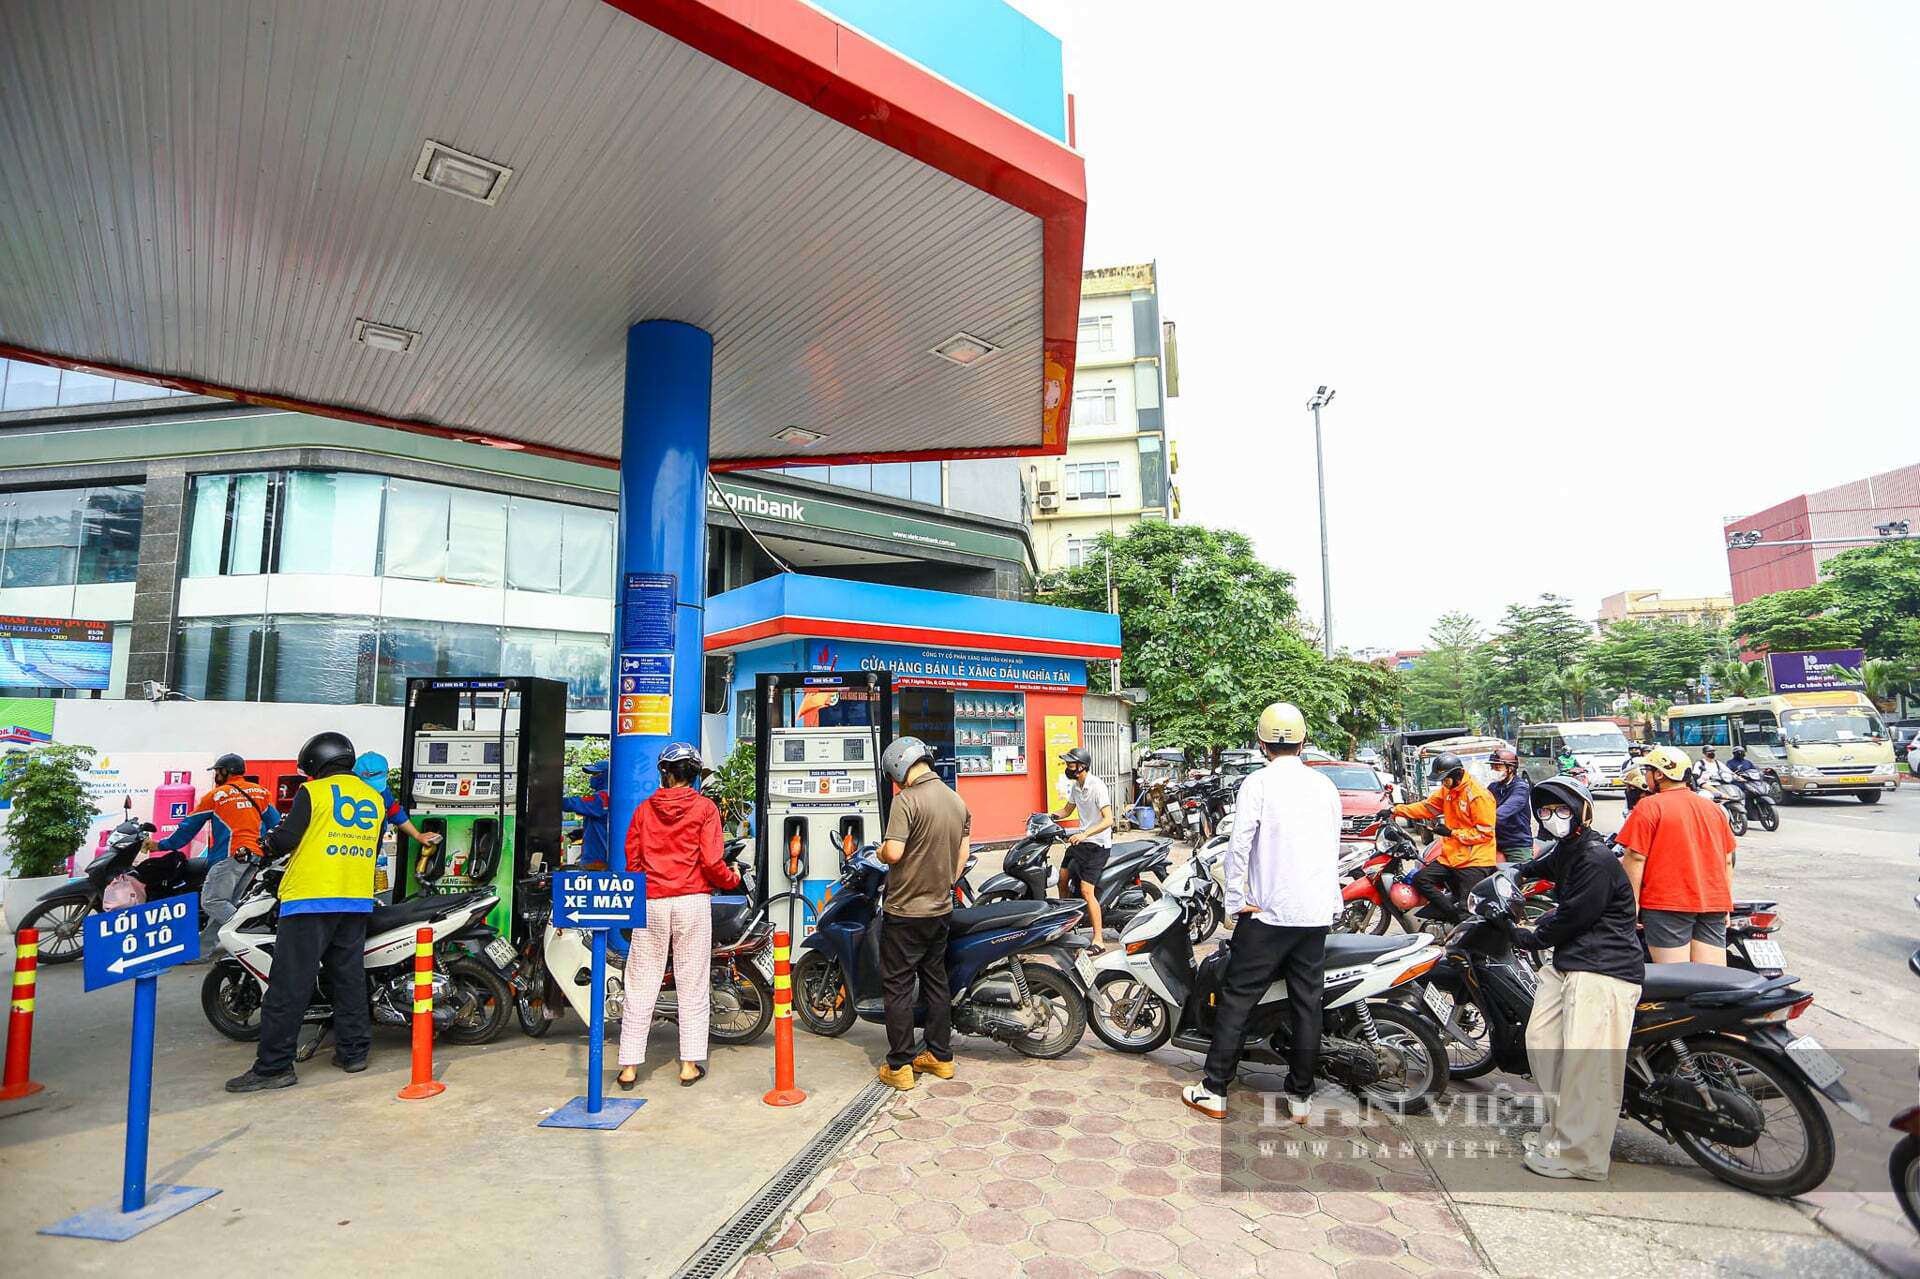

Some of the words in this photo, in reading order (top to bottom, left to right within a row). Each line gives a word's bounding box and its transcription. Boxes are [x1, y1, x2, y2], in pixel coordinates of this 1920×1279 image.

[707, 486, 806, 523] tcombank
[860, 655, 886, 671] CỬA
[889, 658, 922, 674] HÀNG
[925, 660, 949, 675] BÁN
[951, 661, 965, 676] LẺ
[968, 664, 997, 678] XĂNG
[1022, 668, 1051, 681] NGHĨA
[1052, 669, 1071, 682] TÂN
[330, 784, 379, 830] be
[564, 874, 593, 892] LỐI
[597, 873, 635, 892] VÀO
[563, 895, 588, 908] XE
[593, 892, 635, 909] MÁY
[100, 909, 138, 938] LỐI
[144, 902, 187, 926] VÀO
[122, 933, 138, 954] Ô
[144, 925, 173, 948] TÔ
[1325, 970, 1362, 981] LICK
